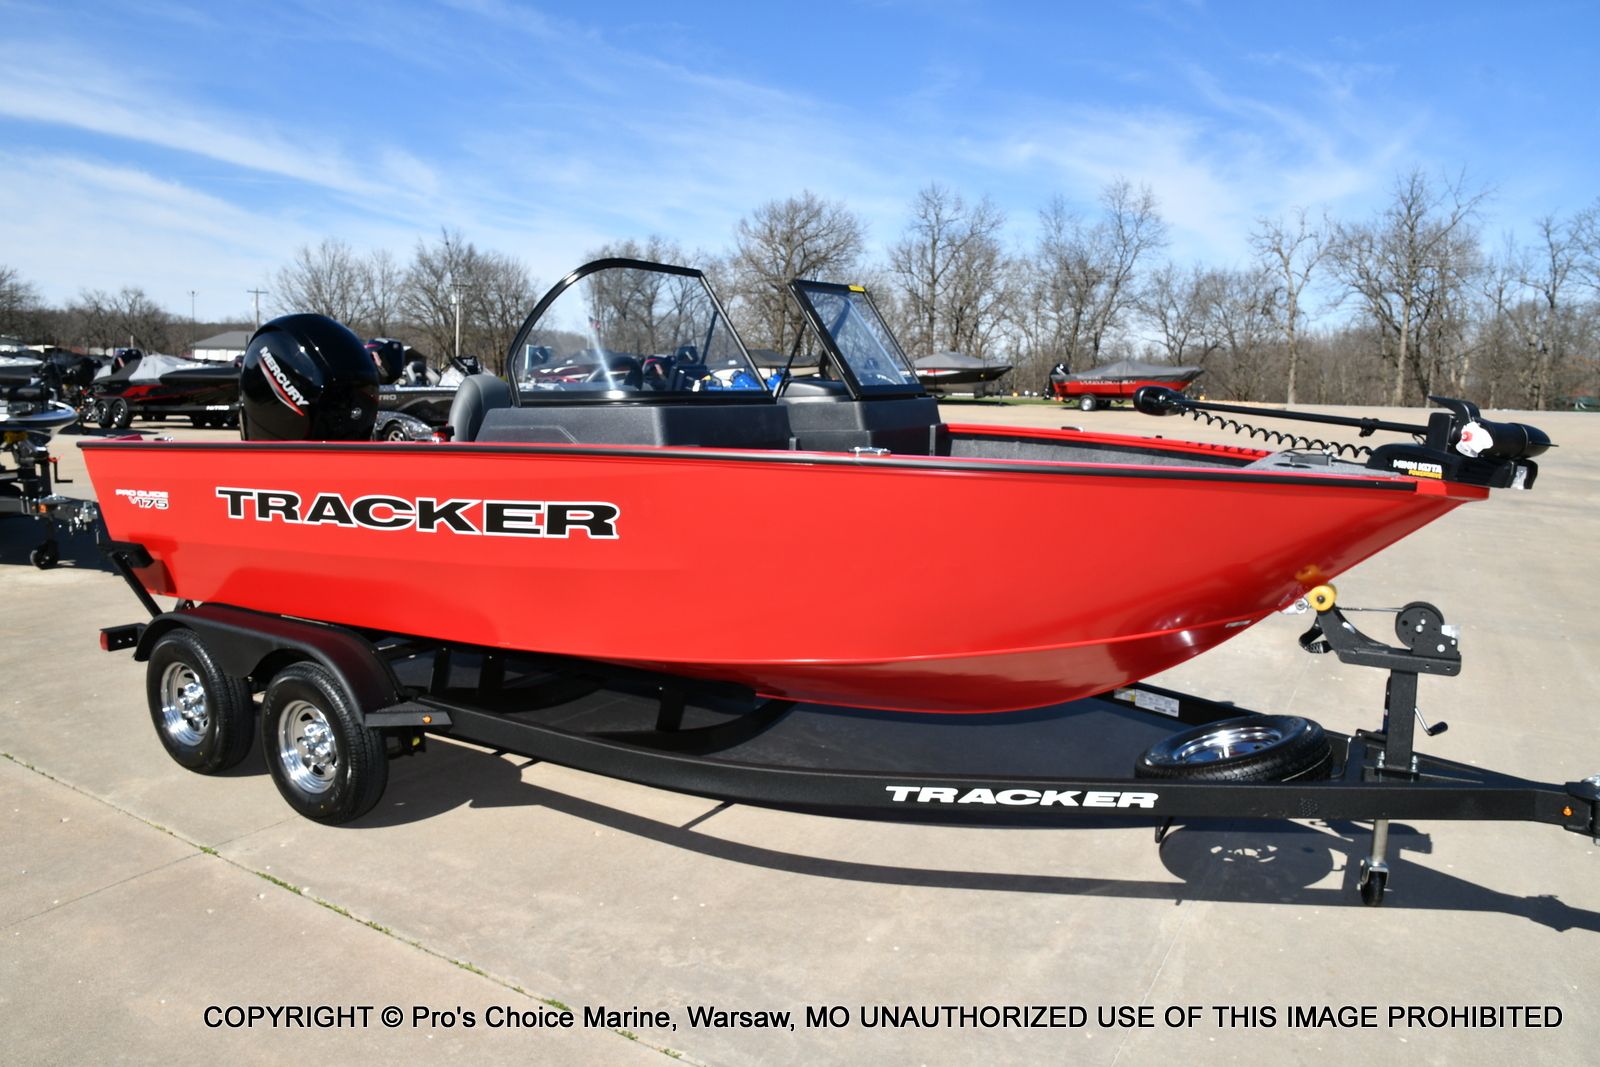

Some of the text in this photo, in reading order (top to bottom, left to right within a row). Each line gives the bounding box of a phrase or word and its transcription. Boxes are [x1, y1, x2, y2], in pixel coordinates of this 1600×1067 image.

[260, 346, 310, 406] MERCURY
[1393, 459, 1442, 474] MINN KOTA
[137, 490, 168, 499] GUIDE
[215, 486, 620, 540] TRACKER
[886, 785, 1159, 809] TRACKER
